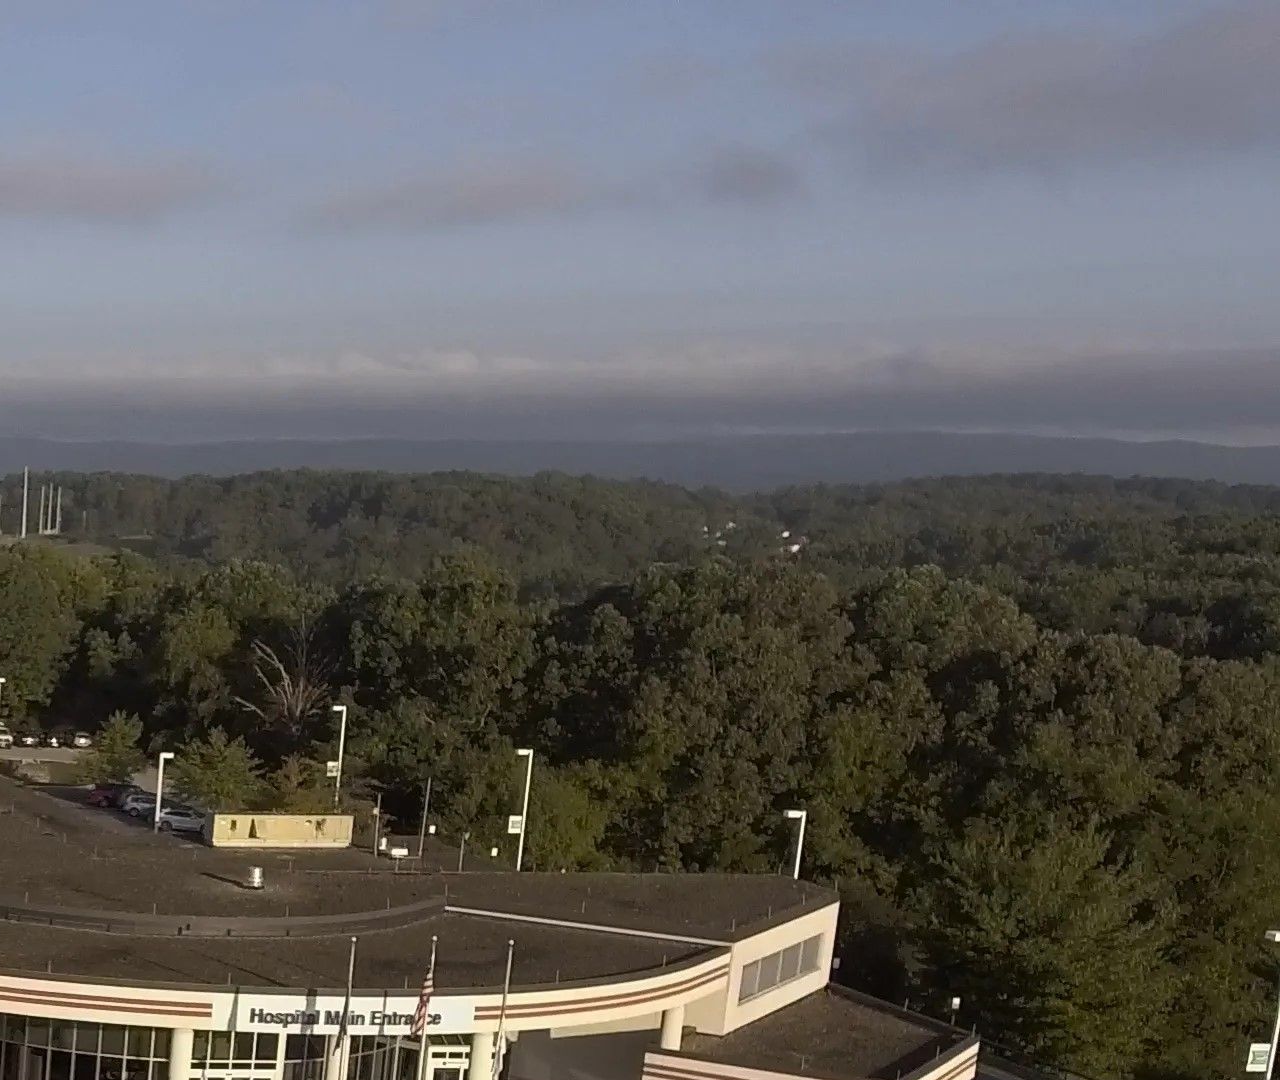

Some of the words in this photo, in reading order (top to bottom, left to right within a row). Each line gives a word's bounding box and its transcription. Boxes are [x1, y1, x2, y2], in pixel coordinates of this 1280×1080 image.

[249, 1008, 320, 1029] Hospital
[324, 1010, 366, 1026] Min
[369, 1010, 442, 1026] Entrace
